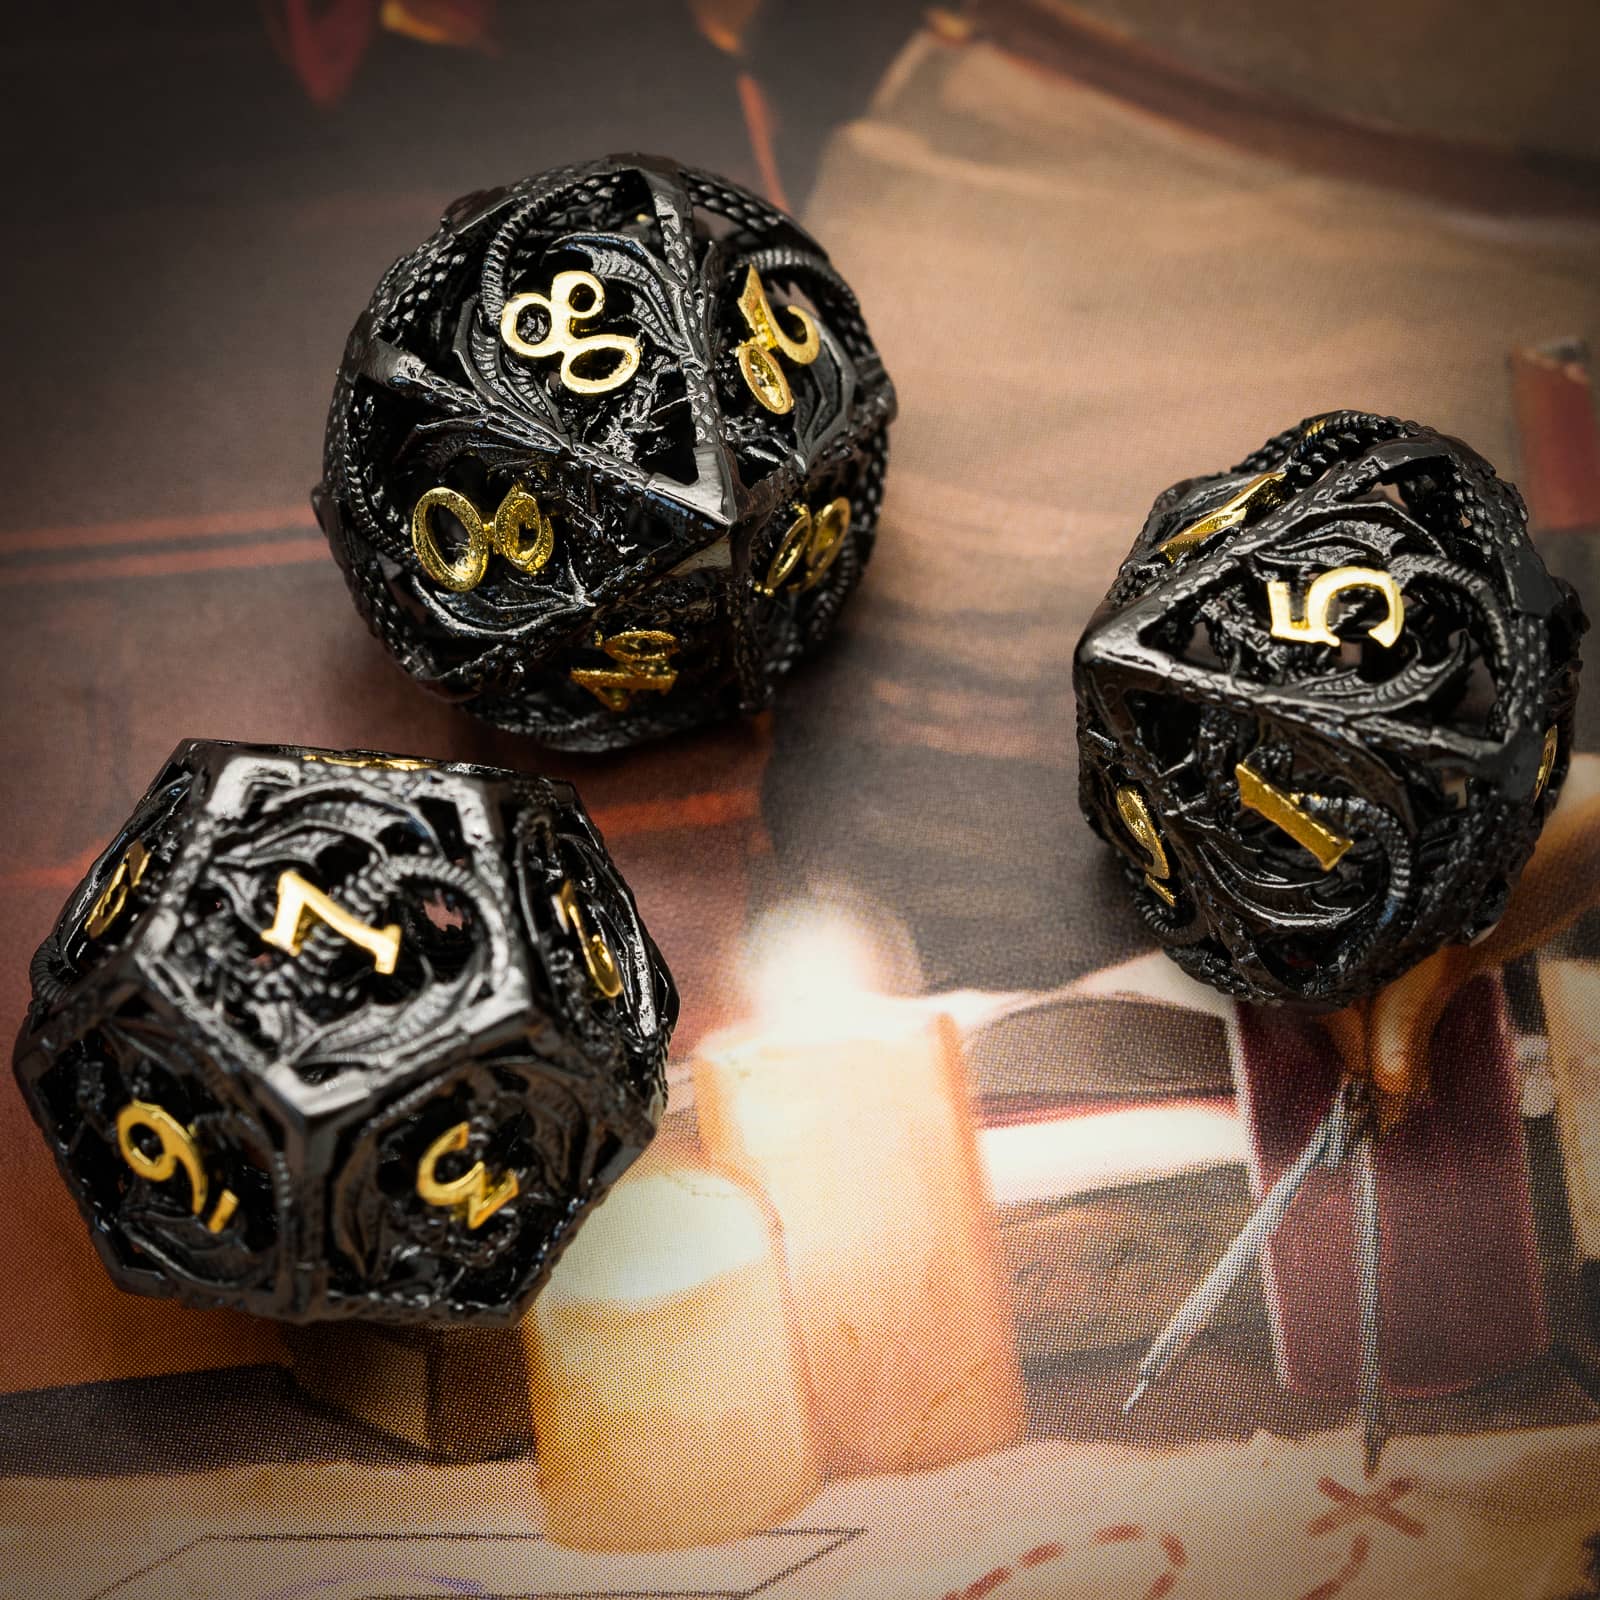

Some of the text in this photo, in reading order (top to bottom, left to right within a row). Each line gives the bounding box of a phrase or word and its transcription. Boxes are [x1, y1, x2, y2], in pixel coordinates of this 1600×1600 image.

[500, 270, 643, 394] 80
[1268, 566, 1405, 648] 5
[416, 1122, 519, 1230] 3
